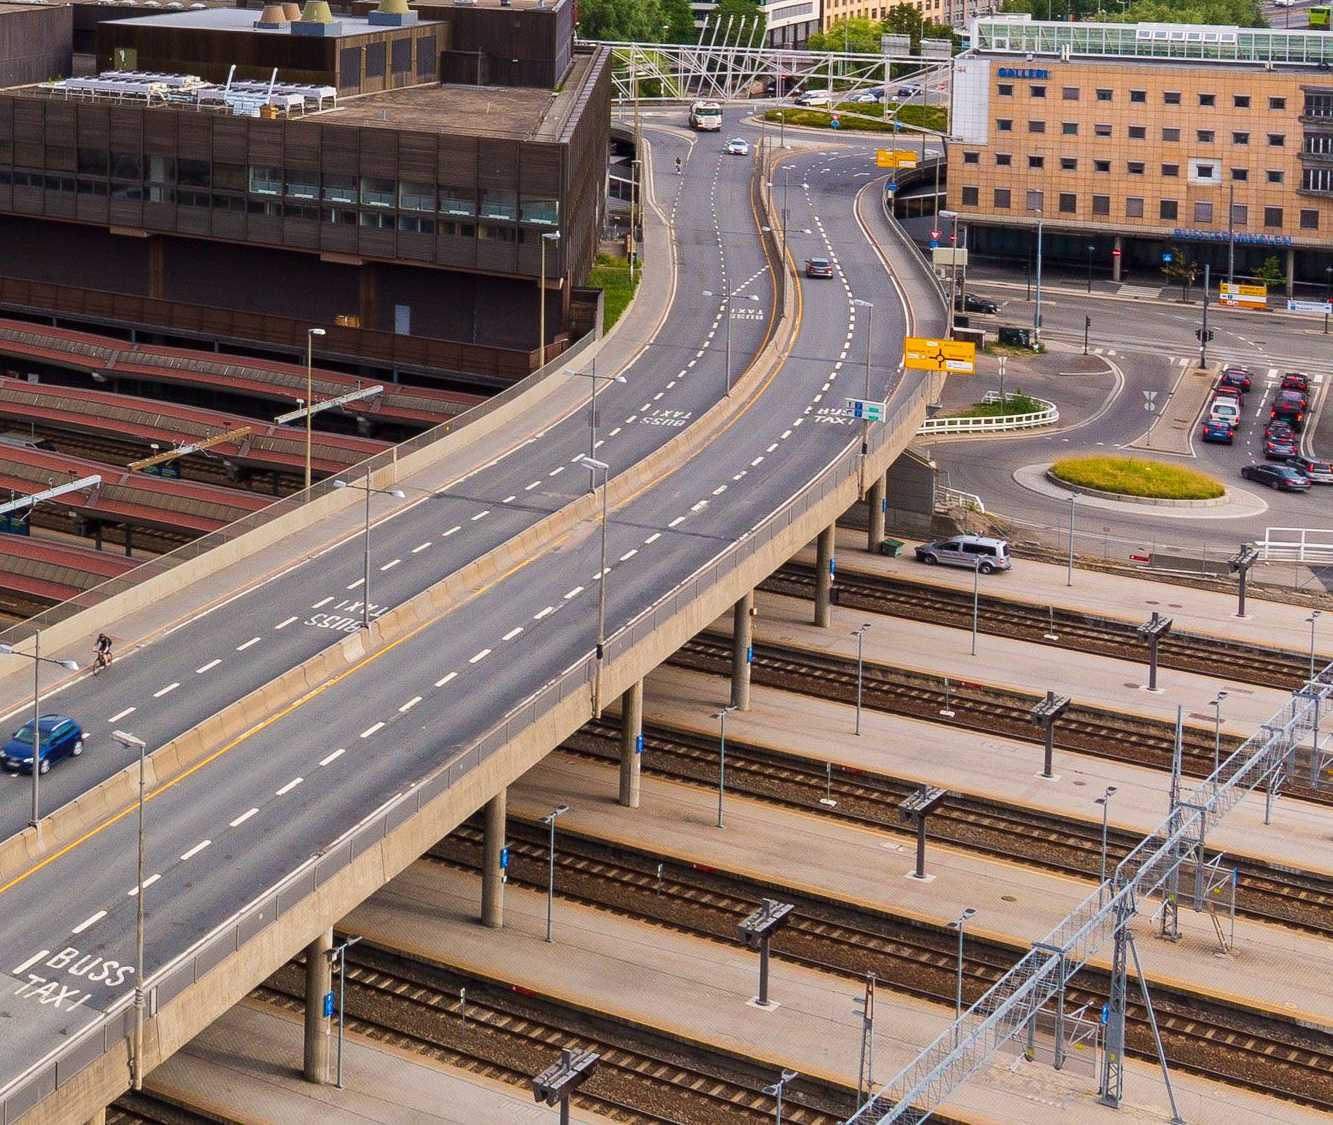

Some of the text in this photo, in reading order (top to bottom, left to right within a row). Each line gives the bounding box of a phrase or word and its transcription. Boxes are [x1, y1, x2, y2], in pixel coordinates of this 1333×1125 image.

[1173, 228, 1293, 246] BUSSTERMINALEN
[640, 416, 687, 427] BUSS
[652, 409, 693, 419] TAXI
[814, 415, 855, 425] TAXI
[334, 600, 389, 617] TAXI
[304, 613, 365, 633] BUSS
[46, 947, 135, 987] BUSS
[14, 973, 92, 1012] TAXI
